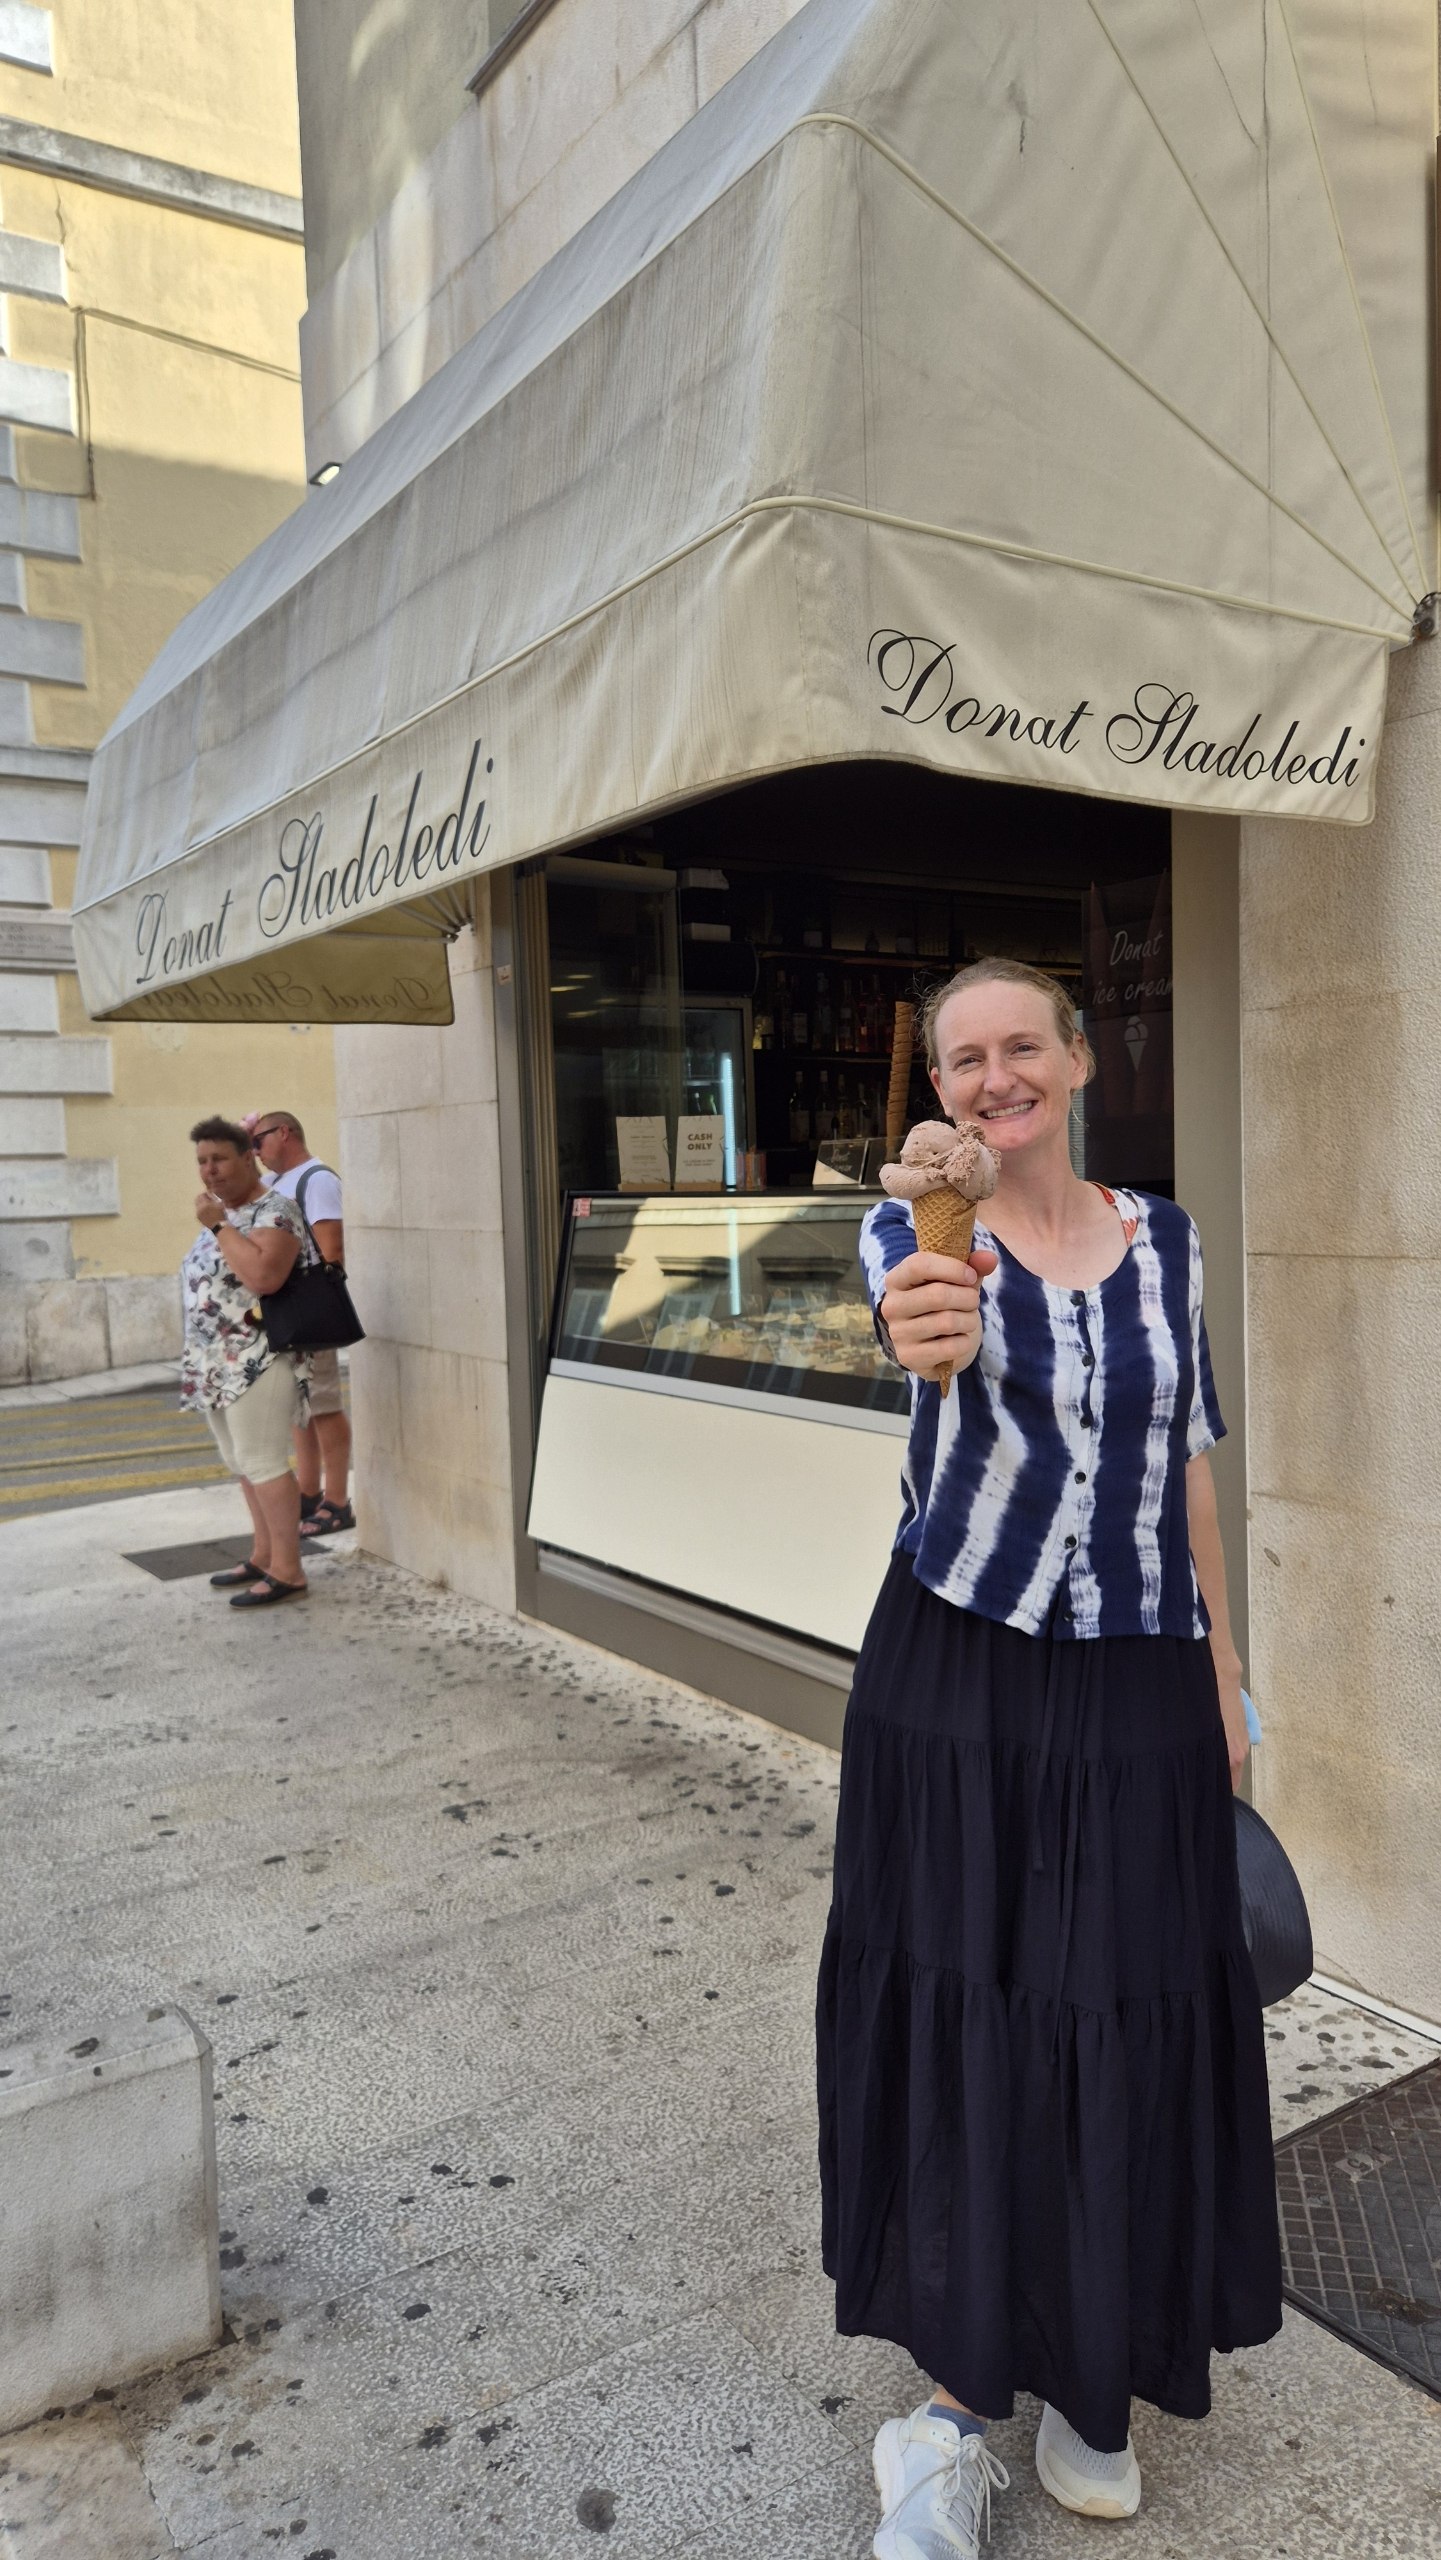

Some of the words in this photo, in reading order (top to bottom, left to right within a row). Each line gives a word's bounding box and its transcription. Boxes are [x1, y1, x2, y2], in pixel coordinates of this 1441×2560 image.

[866, 628, 1094, 754] Donat
[1105, 683, 1367, 787] Sladoledi
[135, 888, 234, 985] Donat
[258, 738, 495, 938] Sladoledi
[1109, 929, 1164, 966] Donat
[1092, 980, 1118, 1005] ice
[687, 1133, 713, 1141] CASH
[687, 1142, 713, 1151] ONLY
